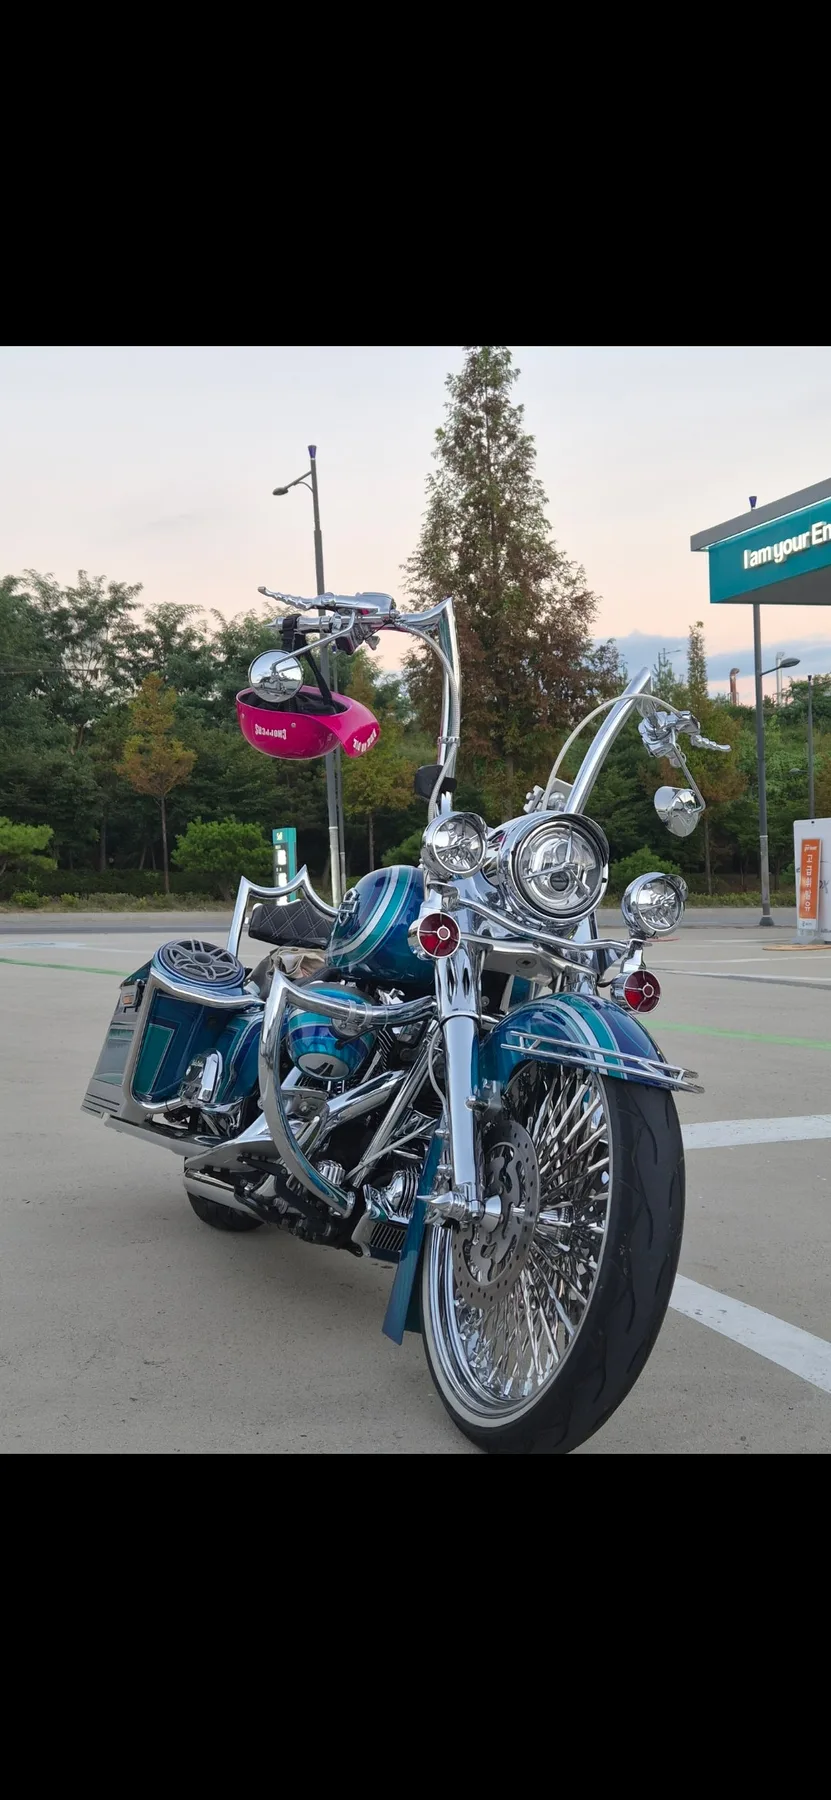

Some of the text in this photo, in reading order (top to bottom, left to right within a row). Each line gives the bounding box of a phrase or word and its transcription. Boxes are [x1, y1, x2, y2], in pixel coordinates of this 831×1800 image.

[743, 549, 750, 570] I
[750, 546, 772, 567] am
[773, 531, 810, 563] your
[254, 723, 287, 740] CHOPPERS
